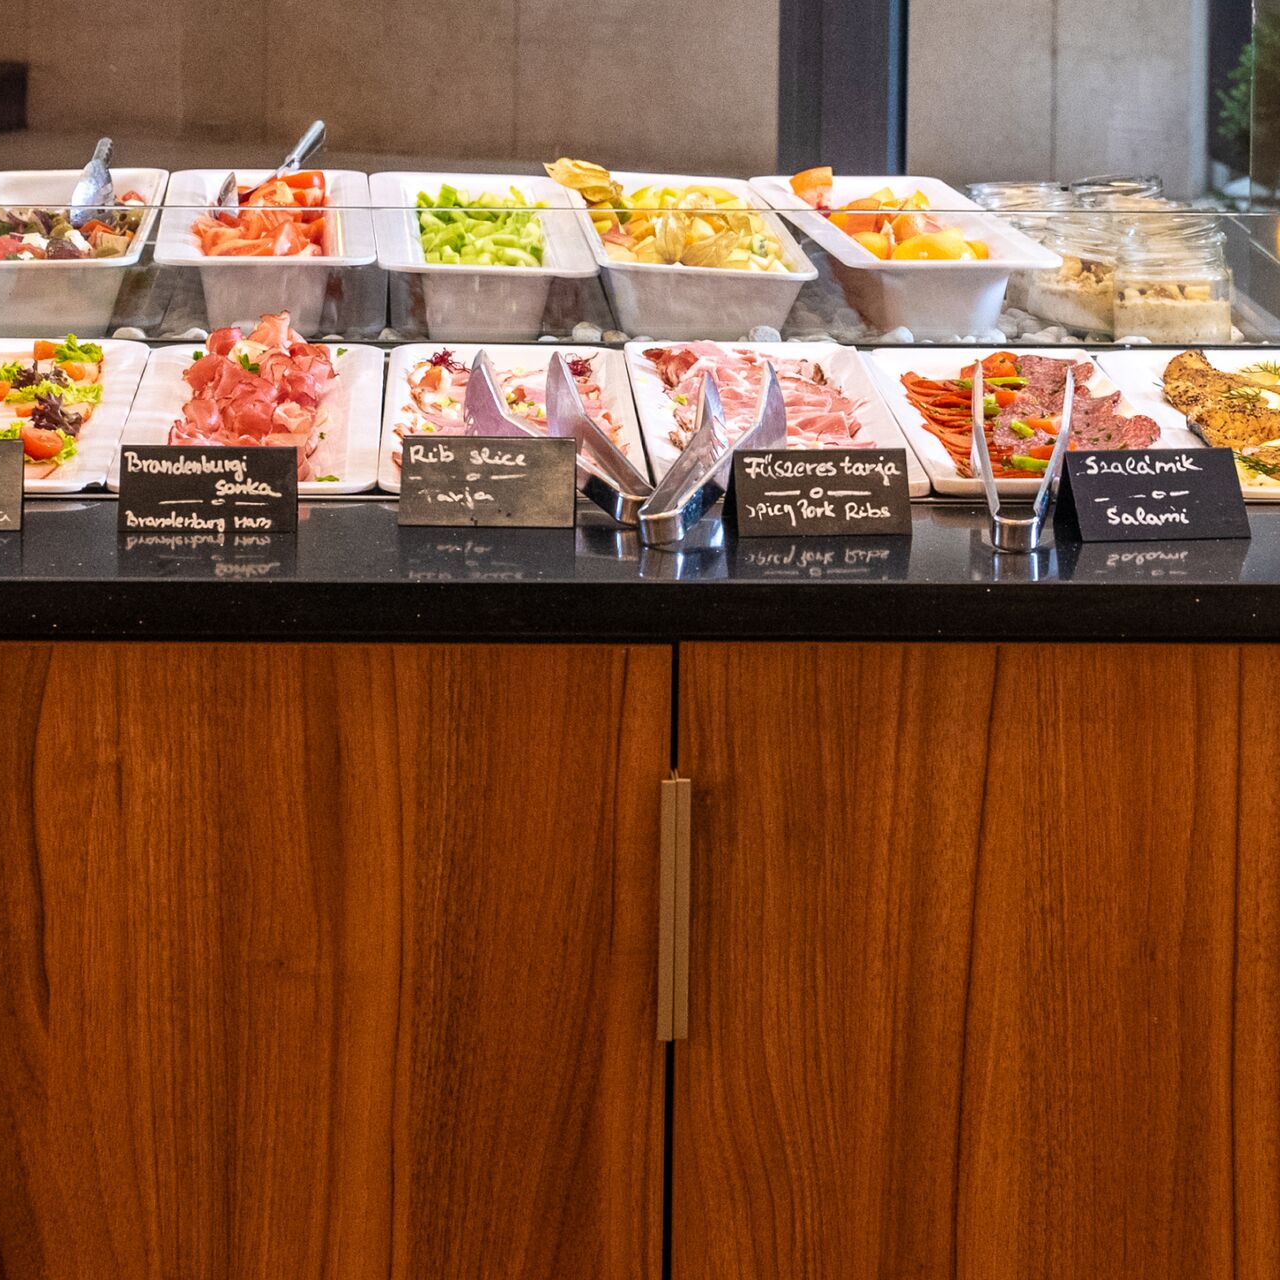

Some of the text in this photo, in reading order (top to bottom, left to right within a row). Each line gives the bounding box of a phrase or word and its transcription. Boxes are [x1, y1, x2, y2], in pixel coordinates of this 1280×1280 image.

[409, 444, 455, 465] Rib
[1084, 454, 1203, 475] Szalámik
[124, 451, 248, 482] Brandenburgi
[839, 456, 902, 486] tarja
[797, 499, 836, 519] Pork
[845, 502, 891, 520] Ribs
[1106, 506, 1190, 526] Salami
[124, 510, 225, 532] Brandenburg
